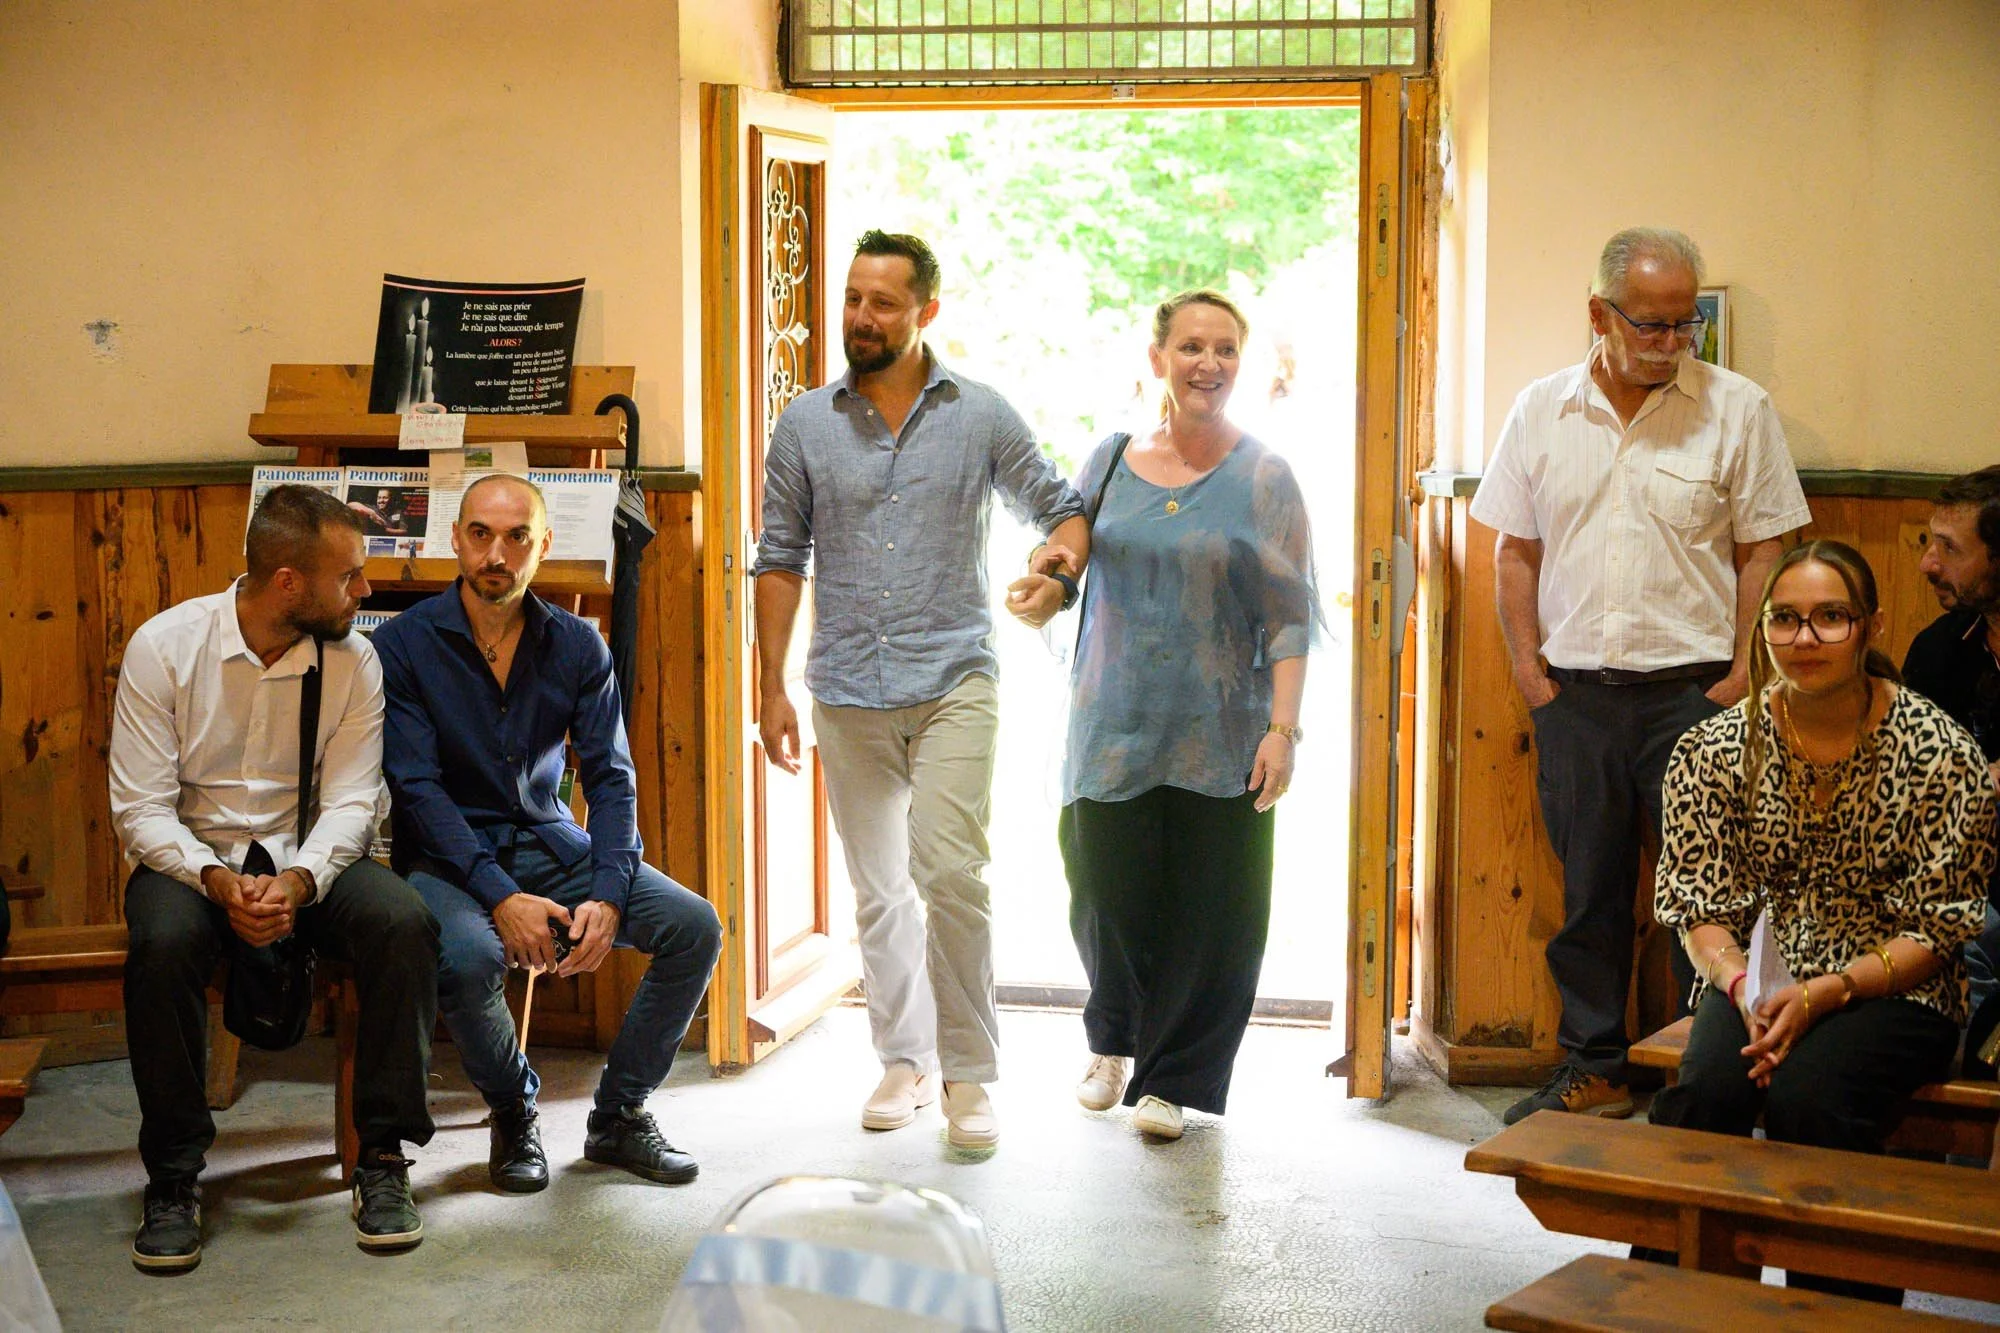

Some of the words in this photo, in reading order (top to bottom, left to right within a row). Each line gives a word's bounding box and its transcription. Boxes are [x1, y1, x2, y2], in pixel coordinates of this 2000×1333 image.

[463, 302, 471, 310] Je
[484, 302, 498, 310] sais
[514, 302, 532, 312] prier
[462, 312, 470, 320] Je
[483, 313, 496, 321] sais
[514, 312, 528, 320] dire
[460, 323, 469, 331] Je
[471, 324, 482, 332] n'ai
[499, 324, 534, 332] beaucoup
[534, 322, 544, 330] de
[545, 322, 564, 330] temps
[536, 376, 558, 384] Seigneur
[468, 404, 489, 412] lumière
[490, 405, 500, 413] qui
